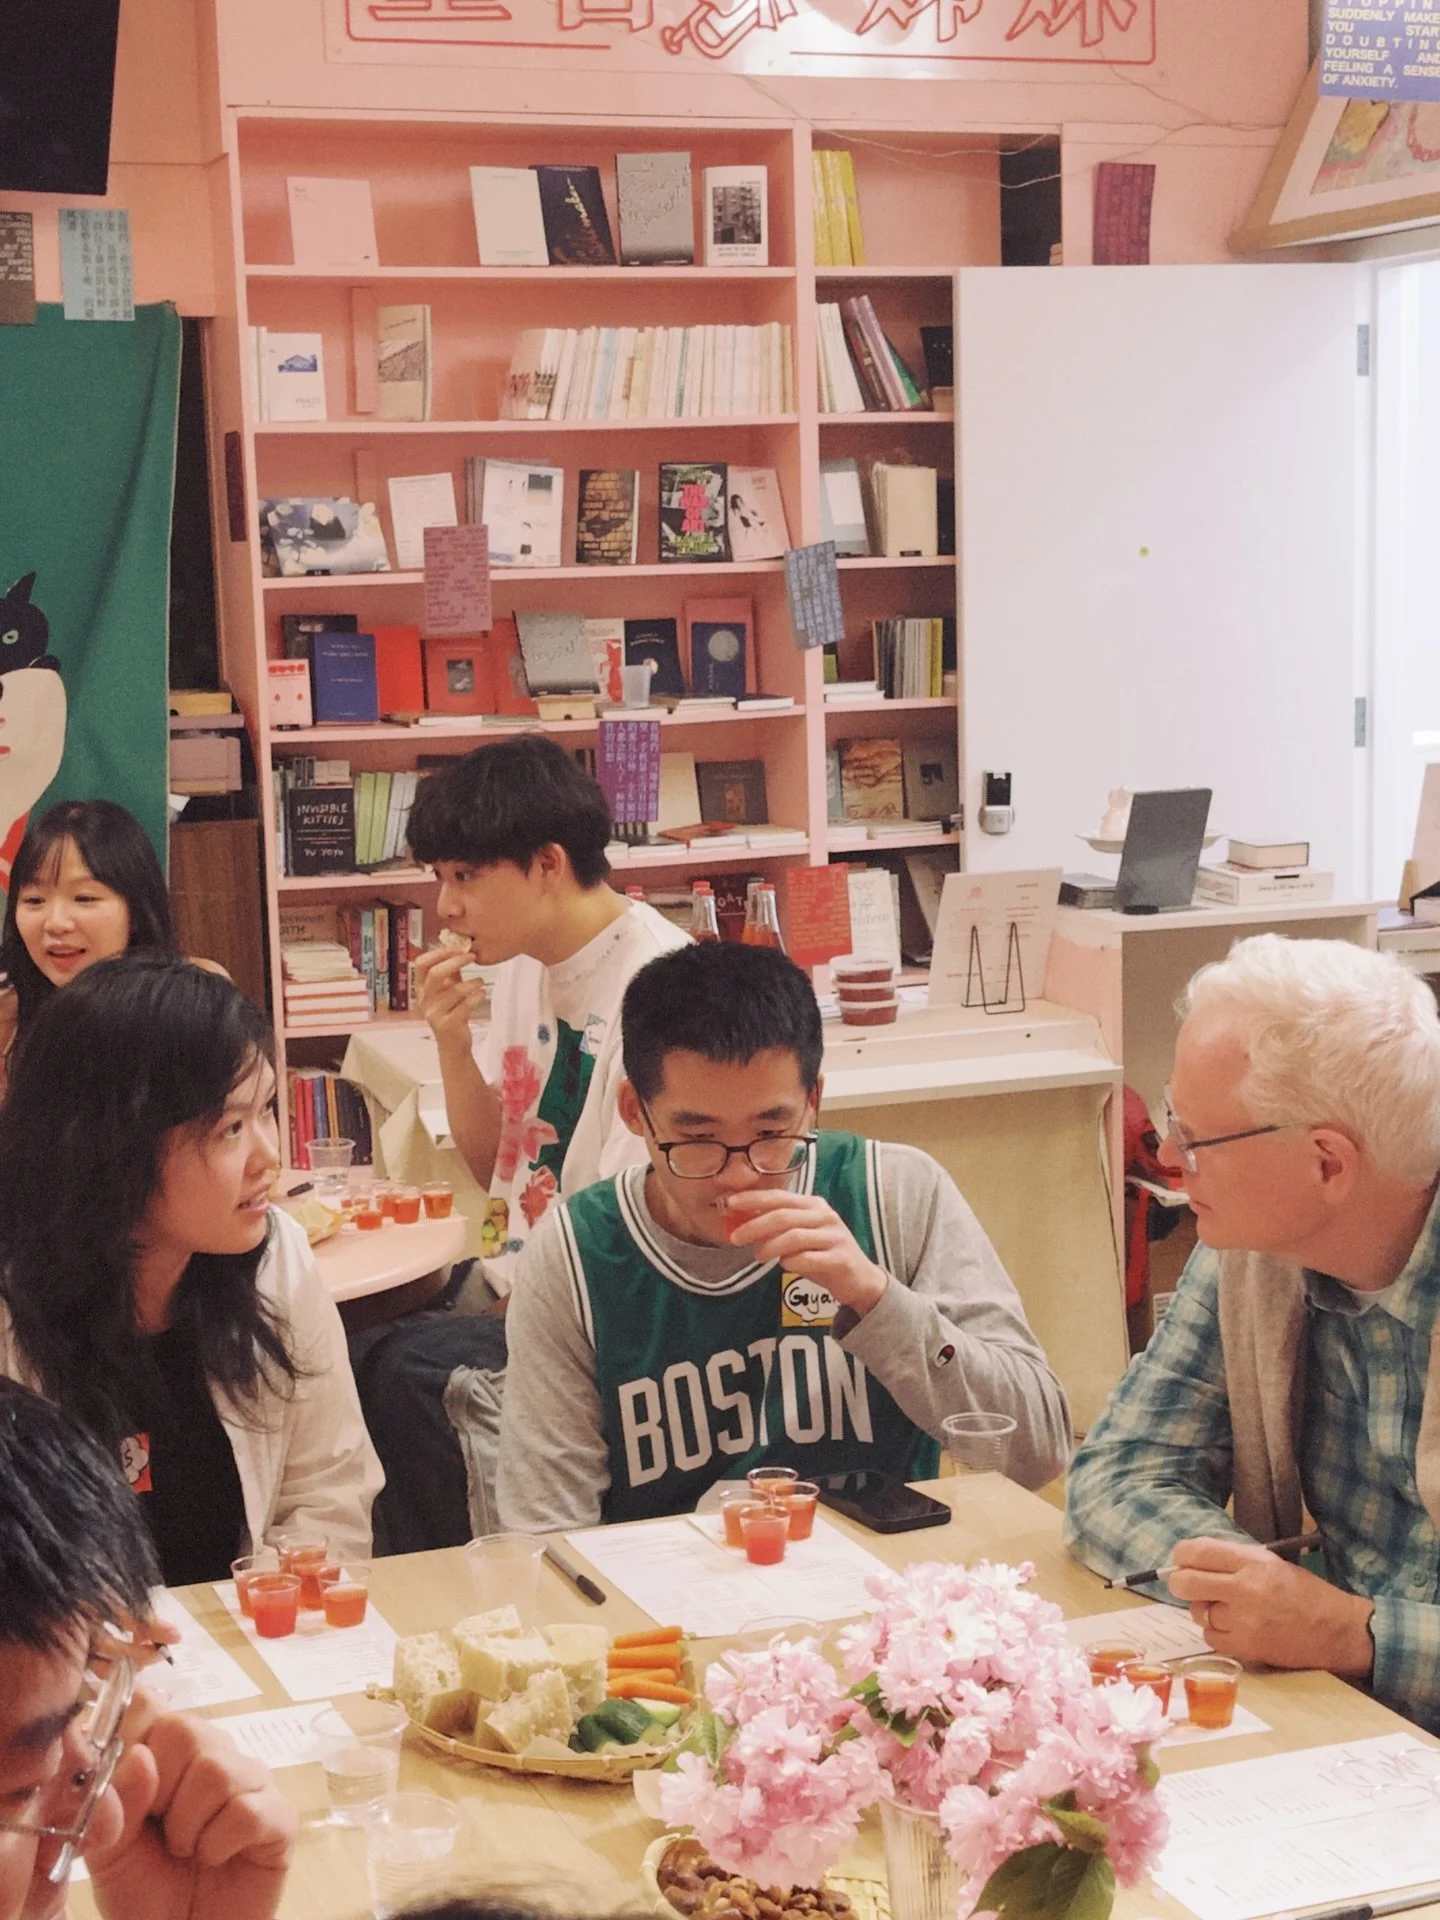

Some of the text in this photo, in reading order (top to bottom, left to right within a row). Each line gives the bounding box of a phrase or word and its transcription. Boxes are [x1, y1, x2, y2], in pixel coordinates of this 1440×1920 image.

[1328, 7, 1396, 21] SUDDENLY
[1327, 20, 1355, 33] YOU
[1326, 47, 1391, 61] YOURSELF
[1323, 60, 1374, 74] FEELING
[1383, 63, 1394, 75] A
[1323, 73, 1399, 89] OF ANXIETY.
[297, 802, 348, 816] INVISIBLE
[618, 1334, 874, 1488] BOSTON
